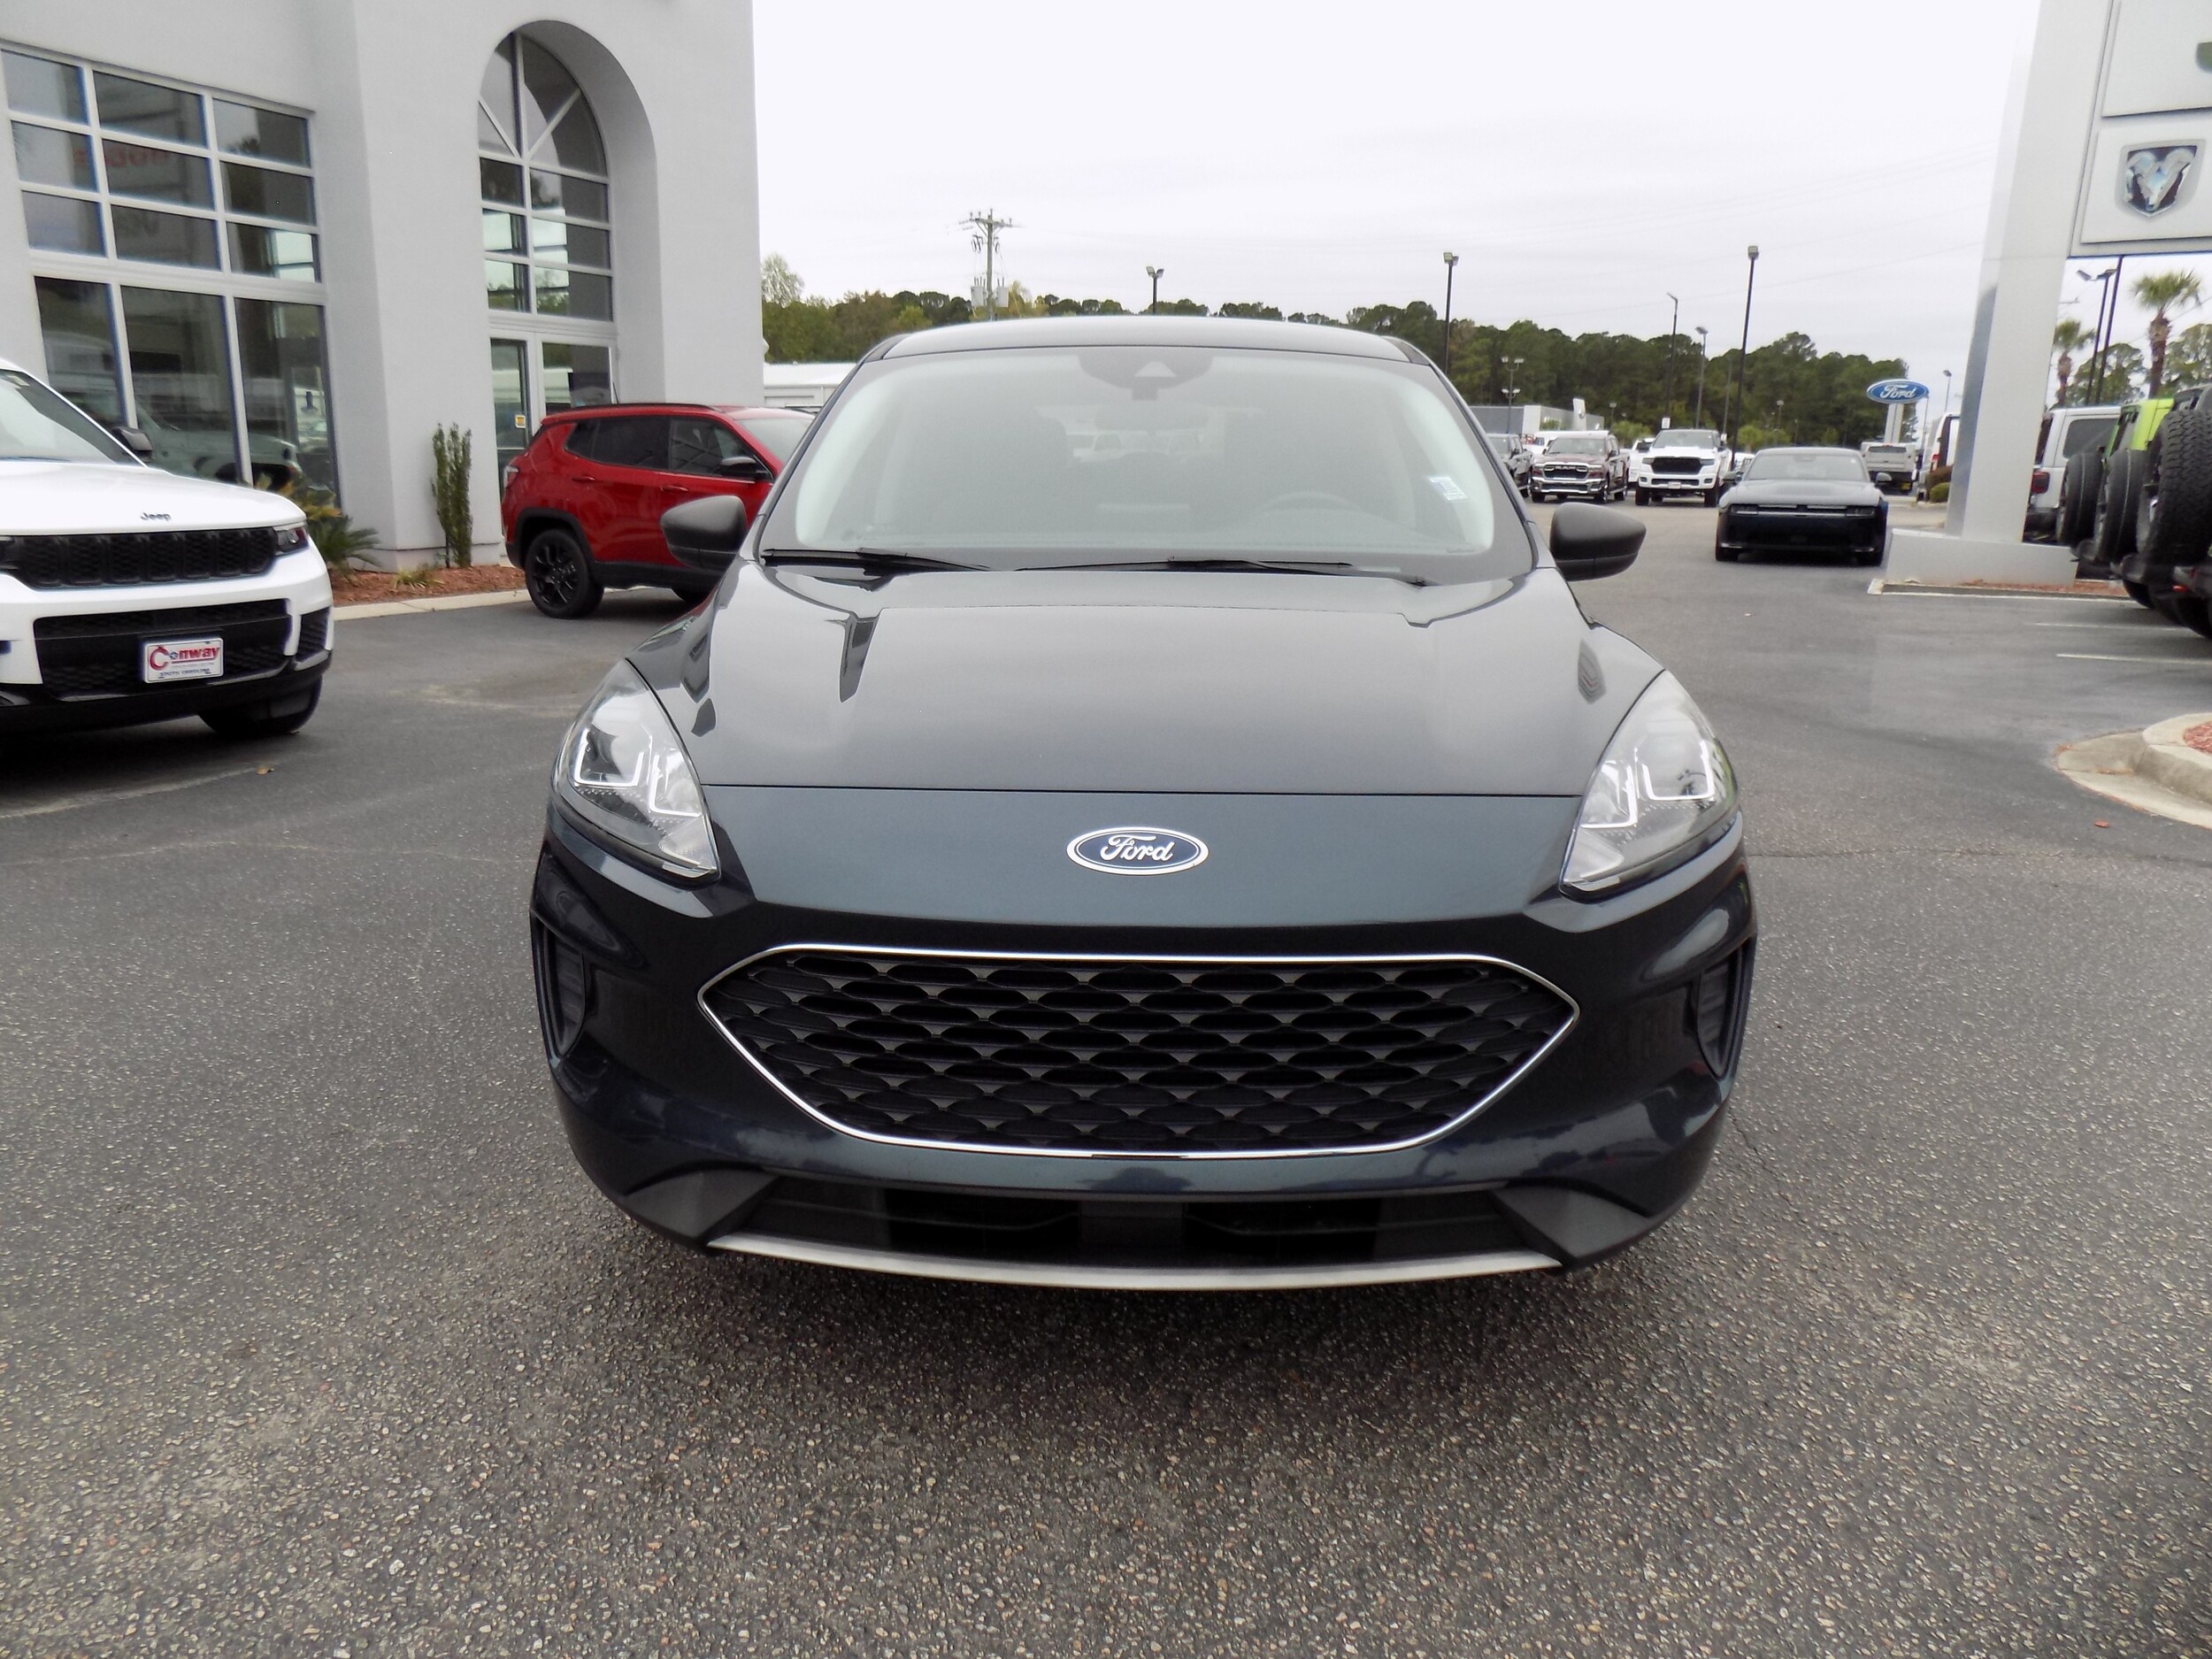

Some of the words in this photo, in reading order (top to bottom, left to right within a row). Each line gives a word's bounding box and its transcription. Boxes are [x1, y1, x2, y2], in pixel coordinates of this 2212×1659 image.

[1879, 384, 1917, 399] Ford
[140, 512, 172, 522] Jeep
[150, 645, 220, 671] Conway
[1100, 834, 1175, 861] Ford
